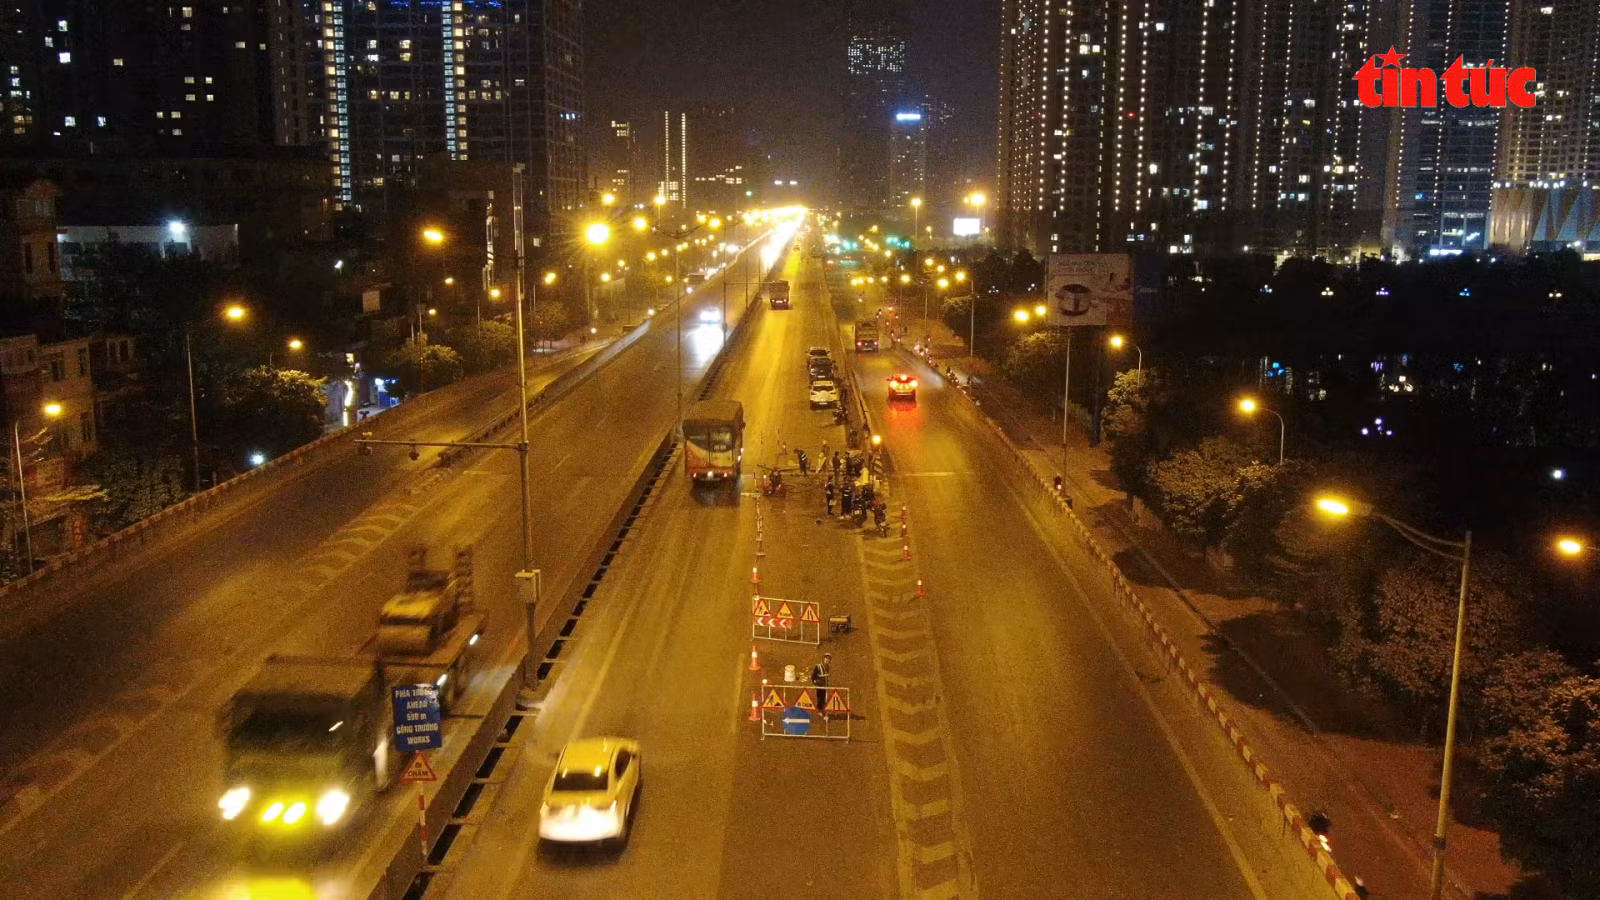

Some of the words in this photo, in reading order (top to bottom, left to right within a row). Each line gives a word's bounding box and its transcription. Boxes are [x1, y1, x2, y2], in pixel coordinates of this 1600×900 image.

[407, 701, 428, 709] AHEAD
[407, 712, 419, 720] 500
[396, 725, 413, 734] CÔNG
[407, 735, 430, 745] WORKS
